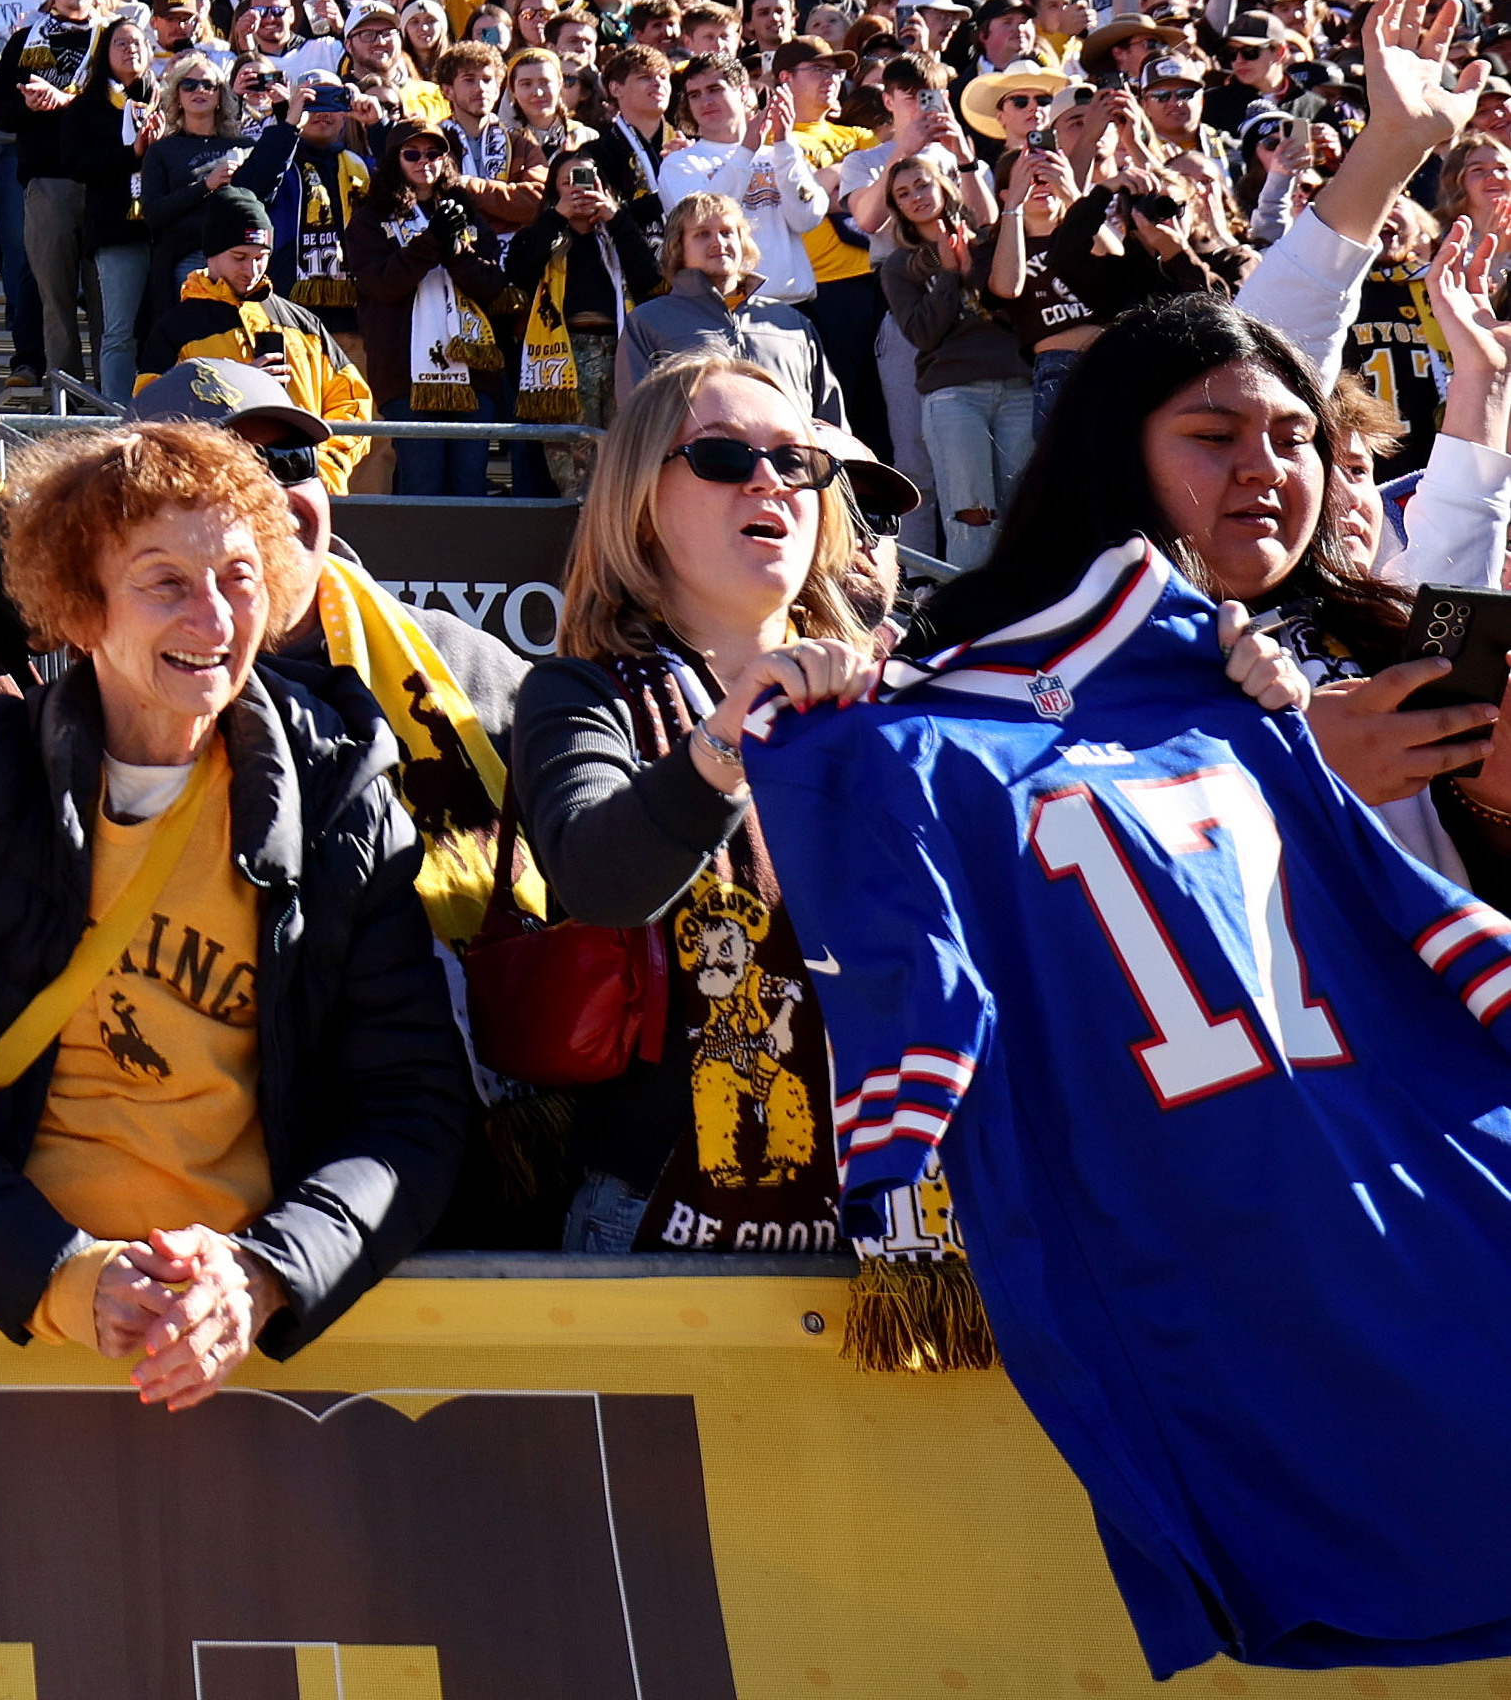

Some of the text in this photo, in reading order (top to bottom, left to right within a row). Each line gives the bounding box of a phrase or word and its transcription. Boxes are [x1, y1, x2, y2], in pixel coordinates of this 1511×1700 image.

[302, 233, 317, 247] BE
[302, 247, 343, 278] 17
[457, 309, 483, 343] 17
[527, 343, 543, 357] DO
[418, 371, 468, 383] COWBOYS
[528, 357, 569, 389] 17
[1036, 691, 1072, 715] NFL
[678, 890, 766, 955] COWBOYS
[1028, 763, 1356, 1112] 17
[107, 911, 259, 1022] ING
[661, 1199, 838, 1251] BE GOOD
